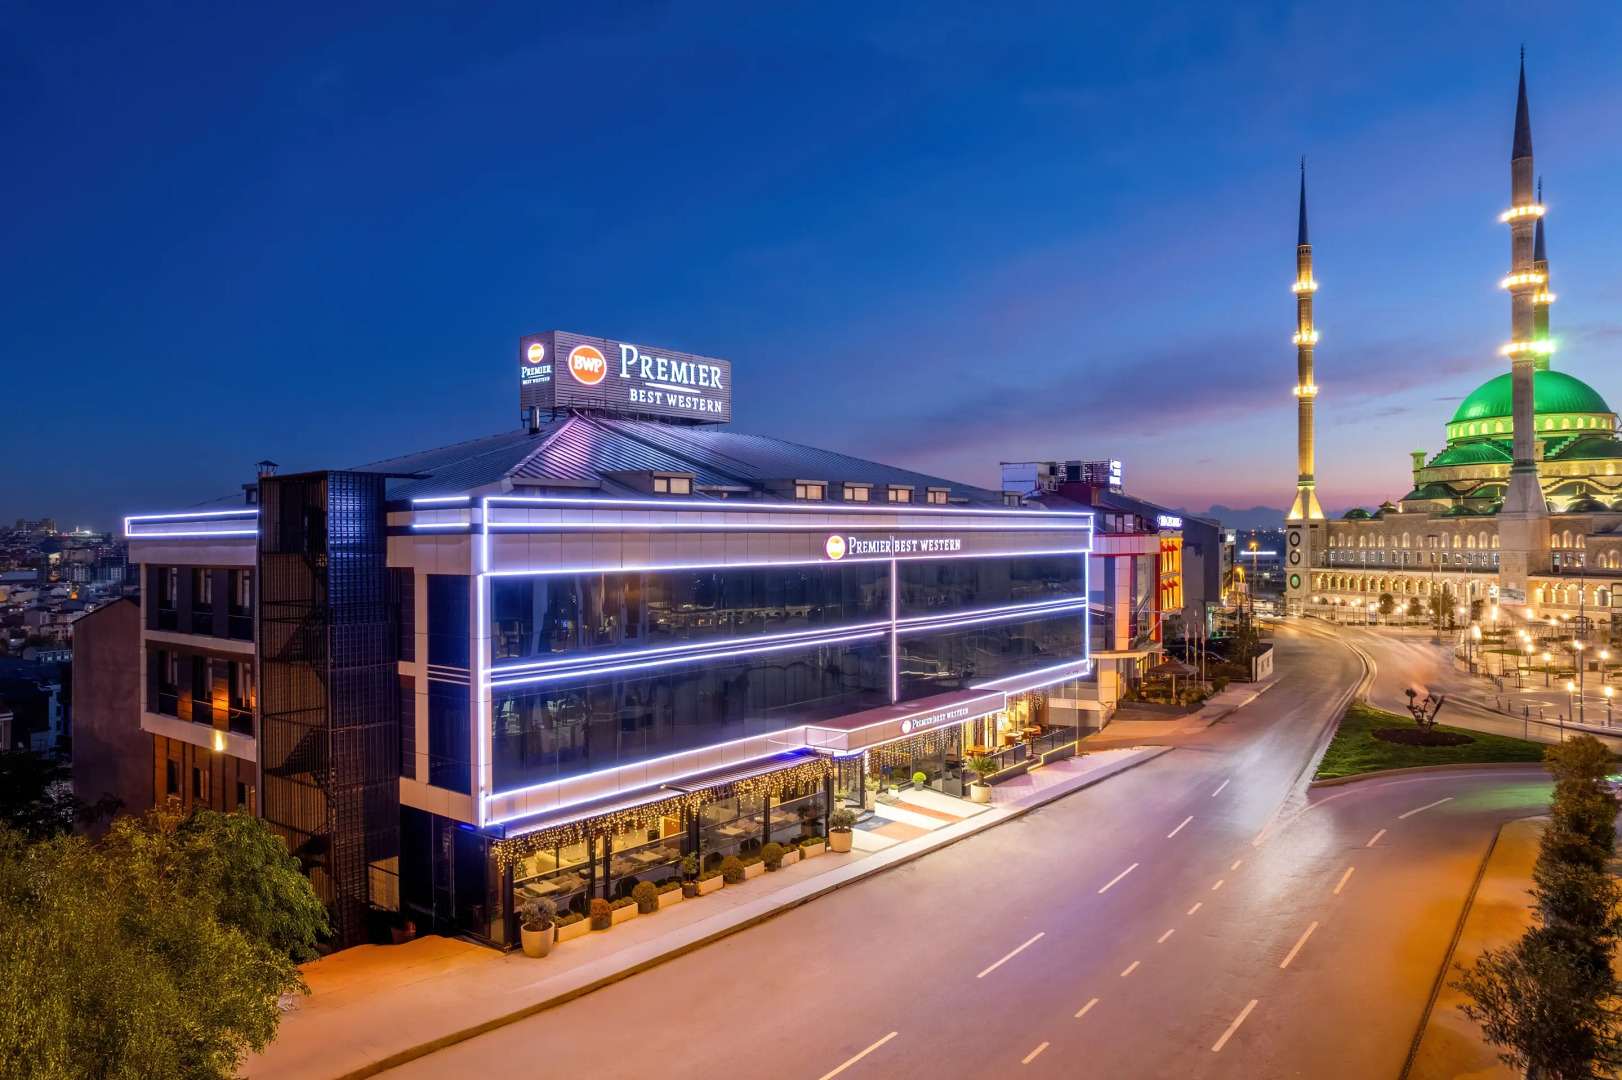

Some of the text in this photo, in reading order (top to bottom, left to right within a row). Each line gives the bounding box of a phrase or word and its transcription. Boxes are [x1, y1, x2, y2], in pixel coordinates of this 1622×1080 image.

[521, 365, 552, 378] PREMIER
[574, 354, 603, 373] BWP
[619, 343, 723, 389] PREMIER
[629, 388, 722, 413] BEST WESTERN
[848, 536, 891, 555] PREMIER
[894, 540, 918, 552] BEST
[920, 539, 961, 552] WESTERN
